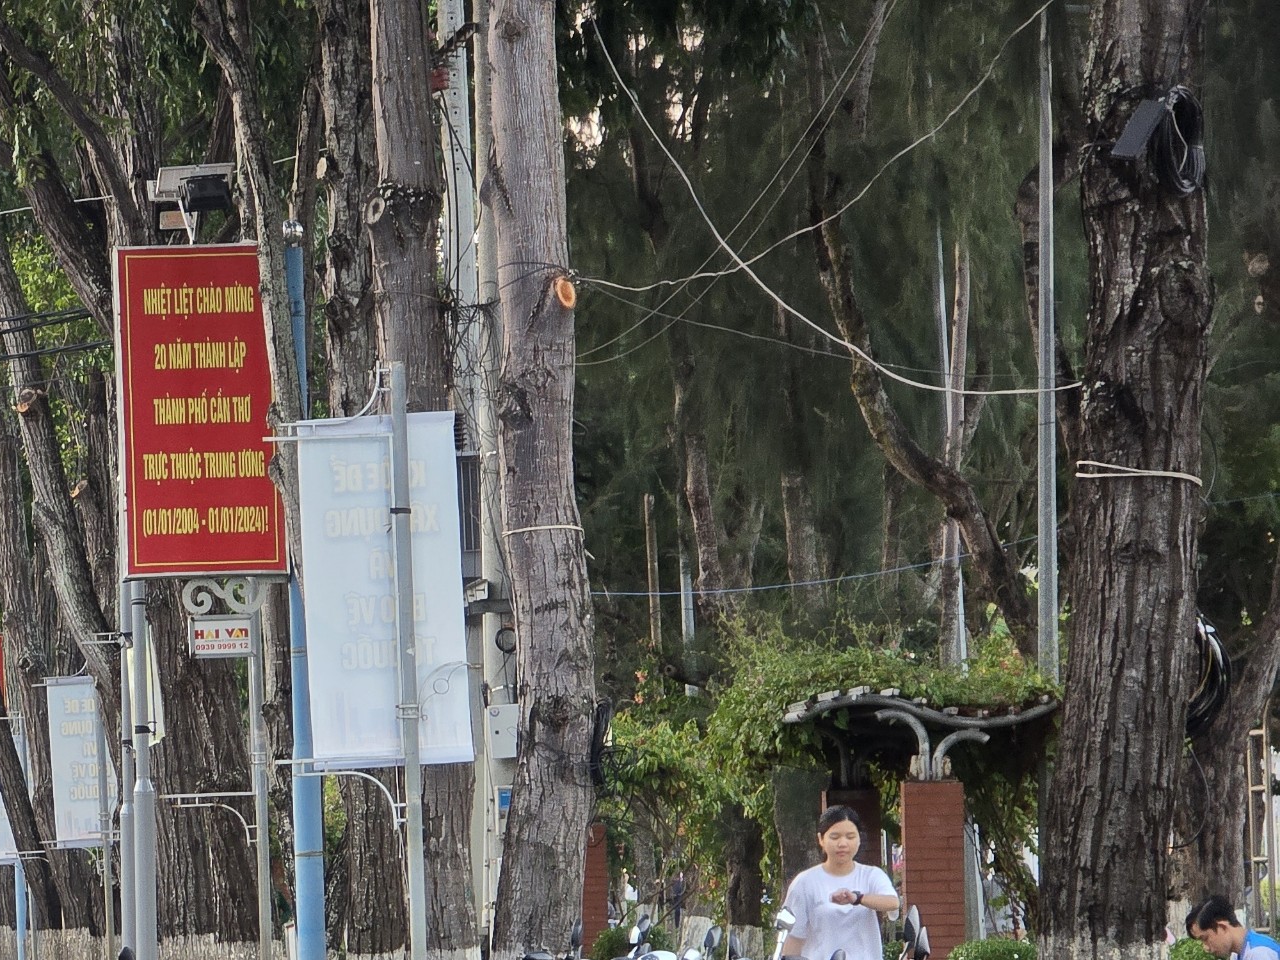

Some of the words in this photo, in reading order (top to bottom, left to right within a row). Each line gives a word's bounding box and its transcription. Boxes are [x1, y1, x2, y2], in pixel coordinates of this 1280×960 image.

[143, 282, 171, 321] NHIỆT
[174, 282, 194, 320] LIỆT
[196, 281, 222, 314] CHÀO
[224, 280, 254, 314] MỪNG
[154, 343, 167, 370] 20
[169, 338, 192, 370] NĂM
[194, 336, 226, 369] THÀNH
[228, 336, 247, 374] LẬP
[153, 392, 186, 425] THÀNH
[188, 387, 208, 424] PHỐ
[210, 387, 230, 424] CẦN
[232, 393, 251, 423] THƠ
[143, 450, 169, 486] TRỰC
[170, 446, 202, 485] THUỘC
[204, 451, 236, 479] TRUNG
[238, 448, 266, 478] ƯƠNG
[143, 507, 199, 538] (01/01/2004
[208, 505, 269, 534] 01/01/2024)!
[195, 643, 215, 651] 0939
